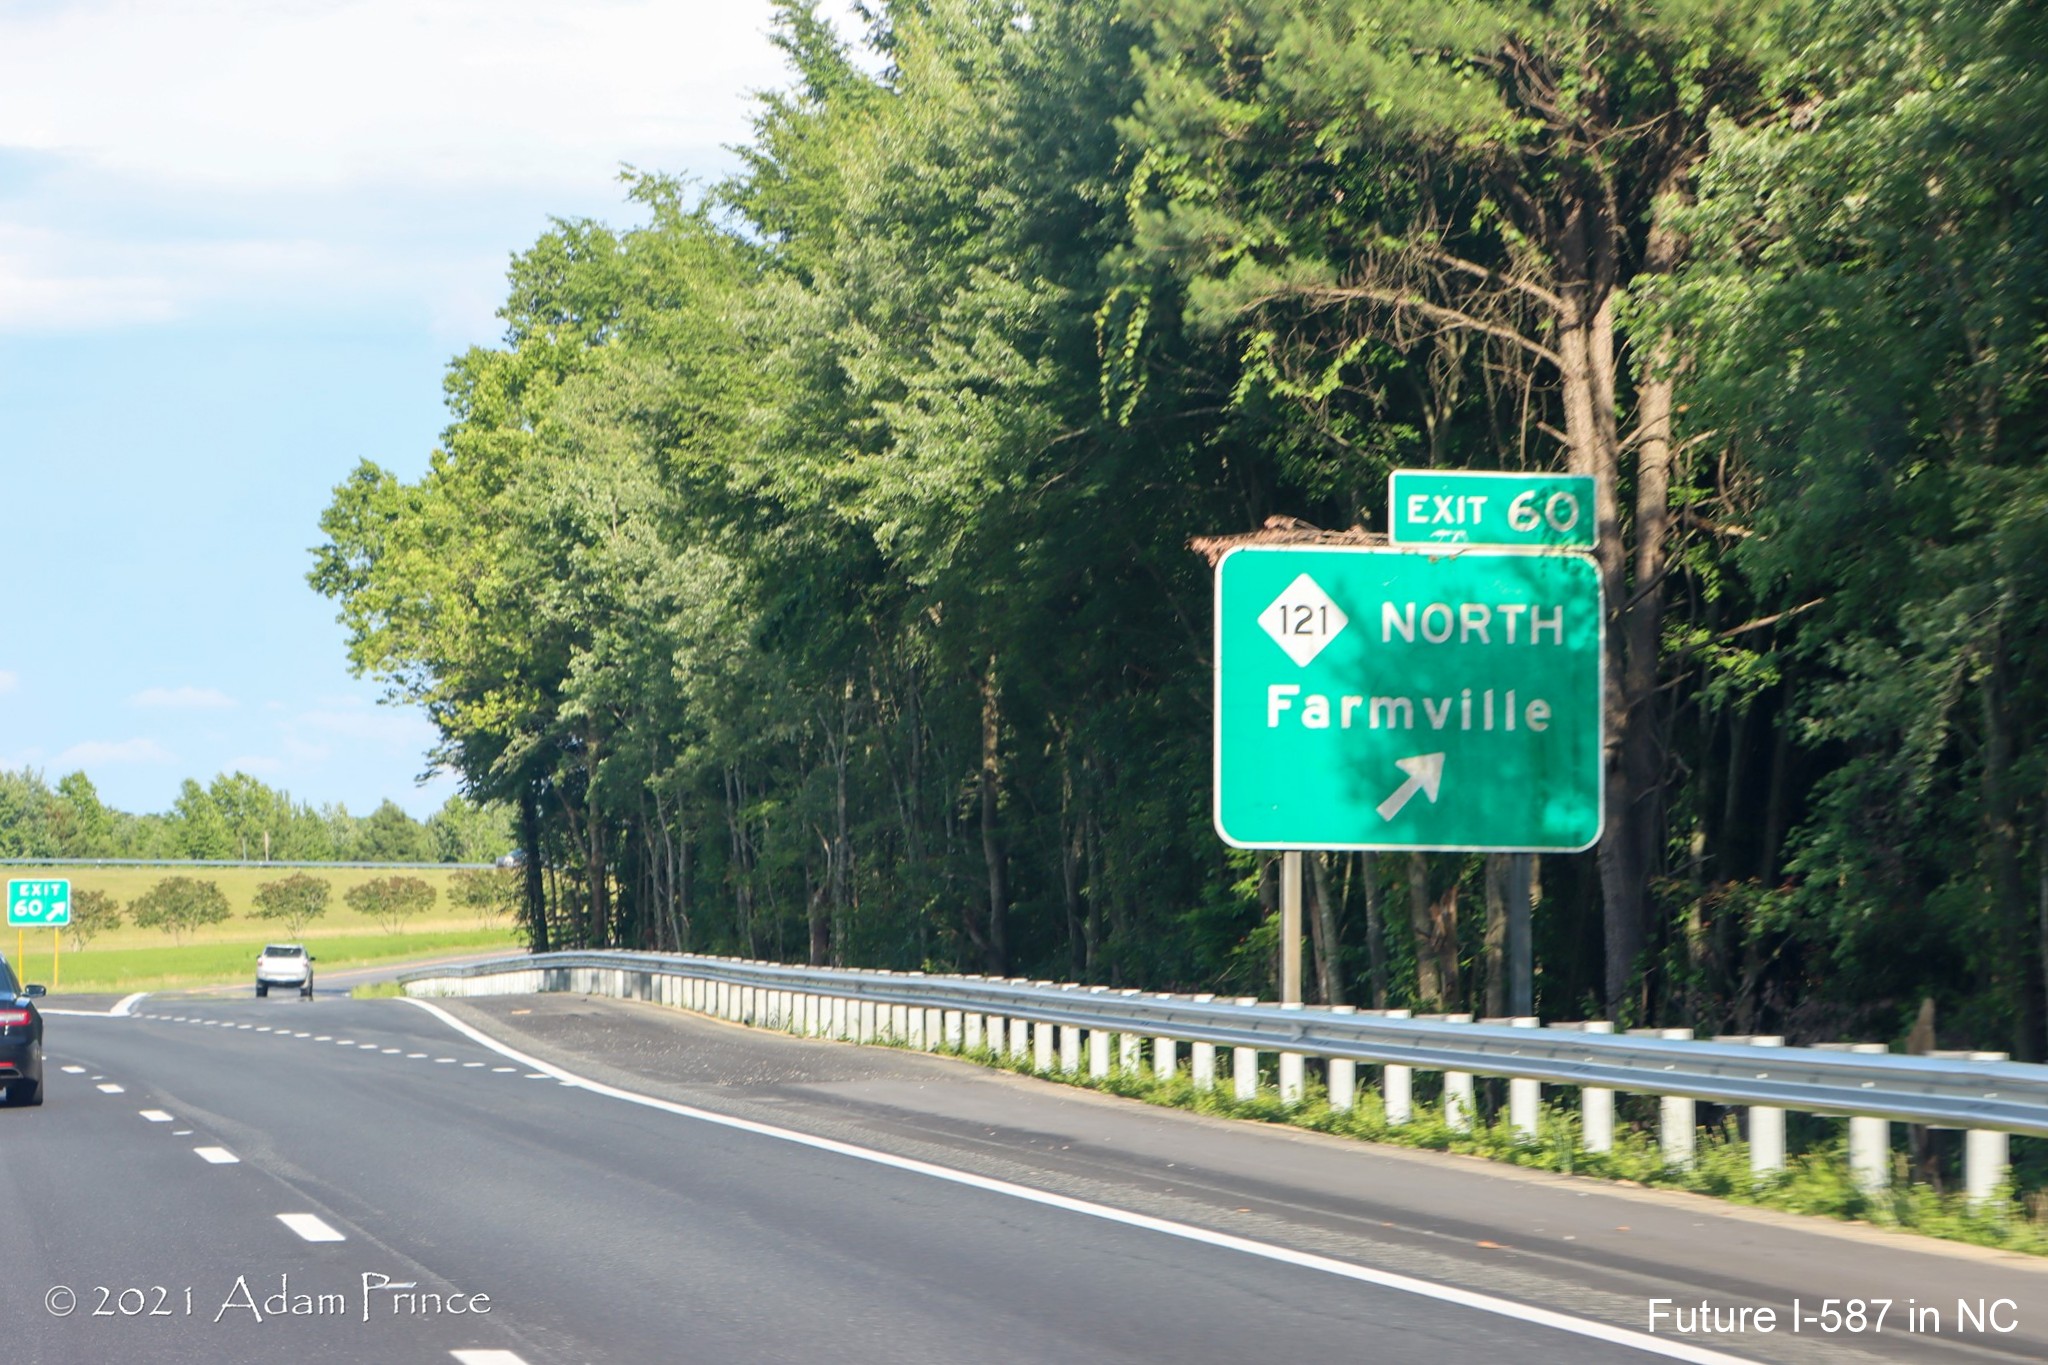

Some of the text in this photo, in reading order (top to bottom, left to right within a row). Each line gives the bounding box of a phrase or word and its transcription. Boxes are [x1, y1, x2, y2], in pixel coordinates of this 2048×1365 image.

[1407, 489, 1580, 533] EXIT 60
[1279, 601, 1564, 646] 121 NORTH
[1267, 684, 1553, 732] Farmville
[13, 899, 43, 917] 60
[19, 883, 61, 897] EXIT
